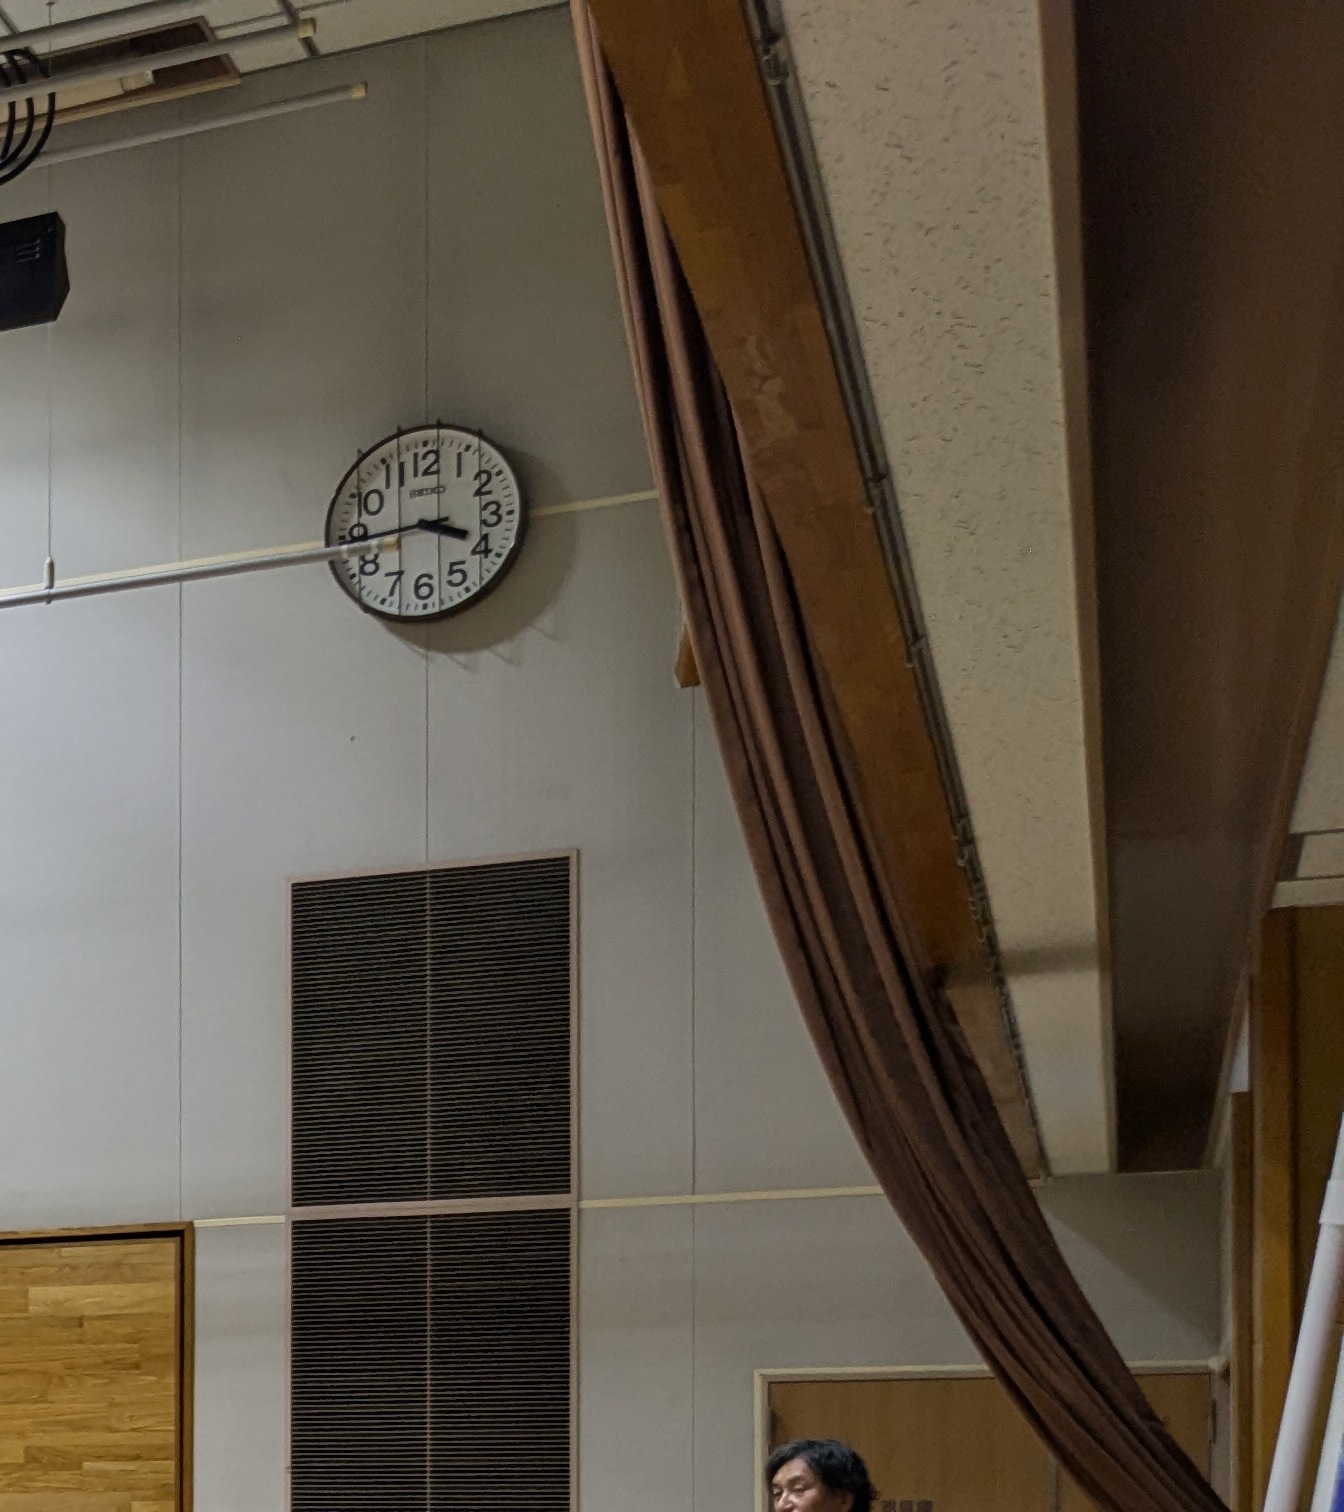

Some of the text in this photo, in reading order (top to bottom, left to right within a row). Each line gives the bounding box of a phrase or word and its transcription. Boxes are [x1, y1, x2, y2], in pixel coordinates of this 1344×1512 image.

[385, 461, 405, 489] 11
[414, 449, 440, 478] 12
[456, 451, 463, 478] 1
[473, 469, 493, 498] 2
[357, 488, 385, 517] 10
[481, 500, 503, 528] 3
[470, 532, 493, 559] 4
[384, 569, 405, 598] 7
[413, 573, 435, 601] 6
[446, 560, 468, 588] 5
